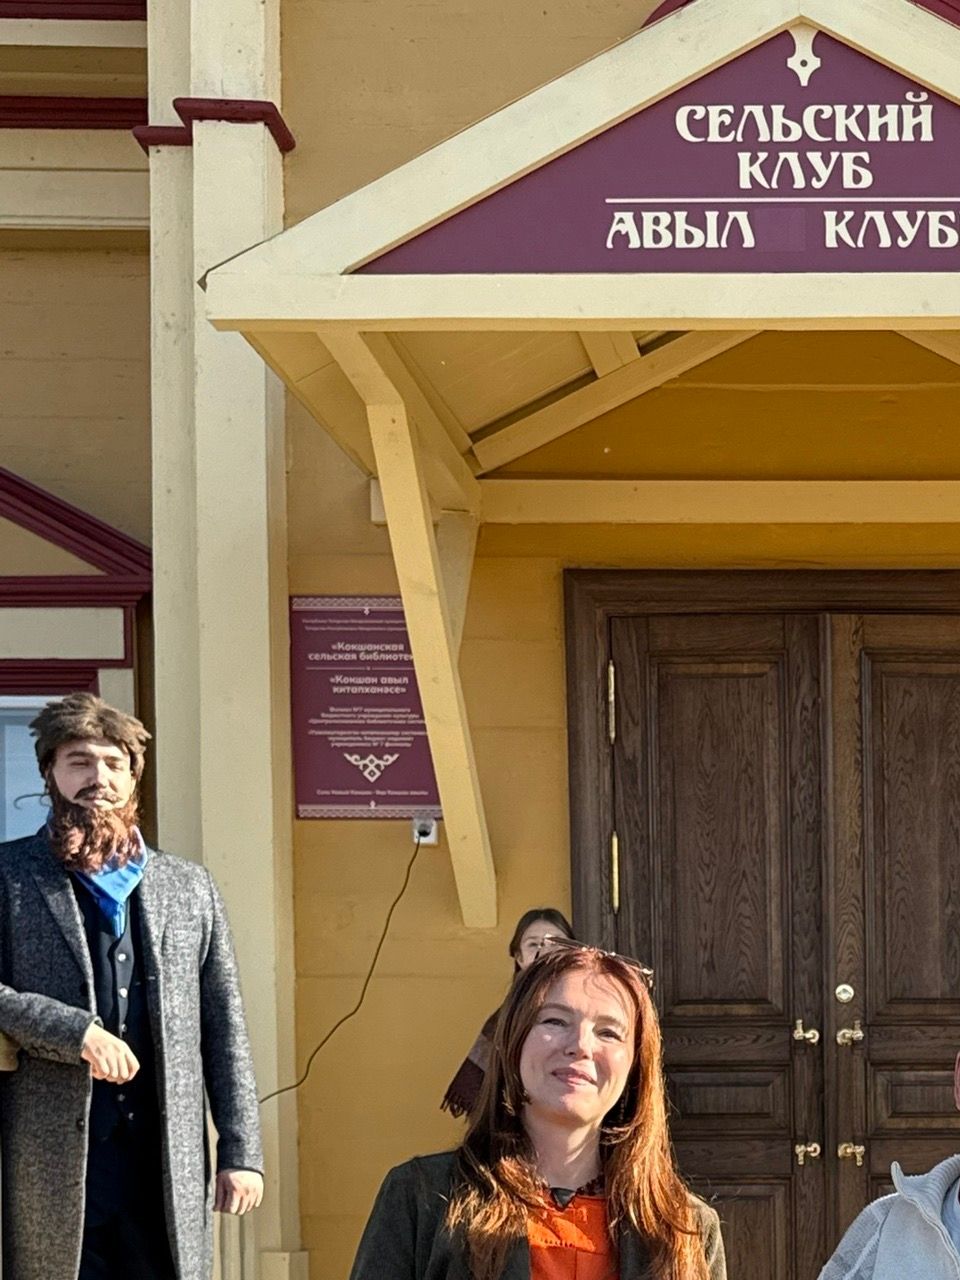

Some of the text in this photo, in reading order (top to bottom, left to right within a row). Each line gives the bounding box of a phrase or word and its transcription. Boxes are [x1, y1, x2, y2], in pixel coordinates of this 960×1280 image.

[674, 91, 934, 142] СЕЛЬСКИЙ
[737, 151, 874, 189] КЛУБ
[606, 210, 755, 248] АВЫЛ
[308, 652, 357, 661] сельская
[380, 676, 409, 685] авыл
